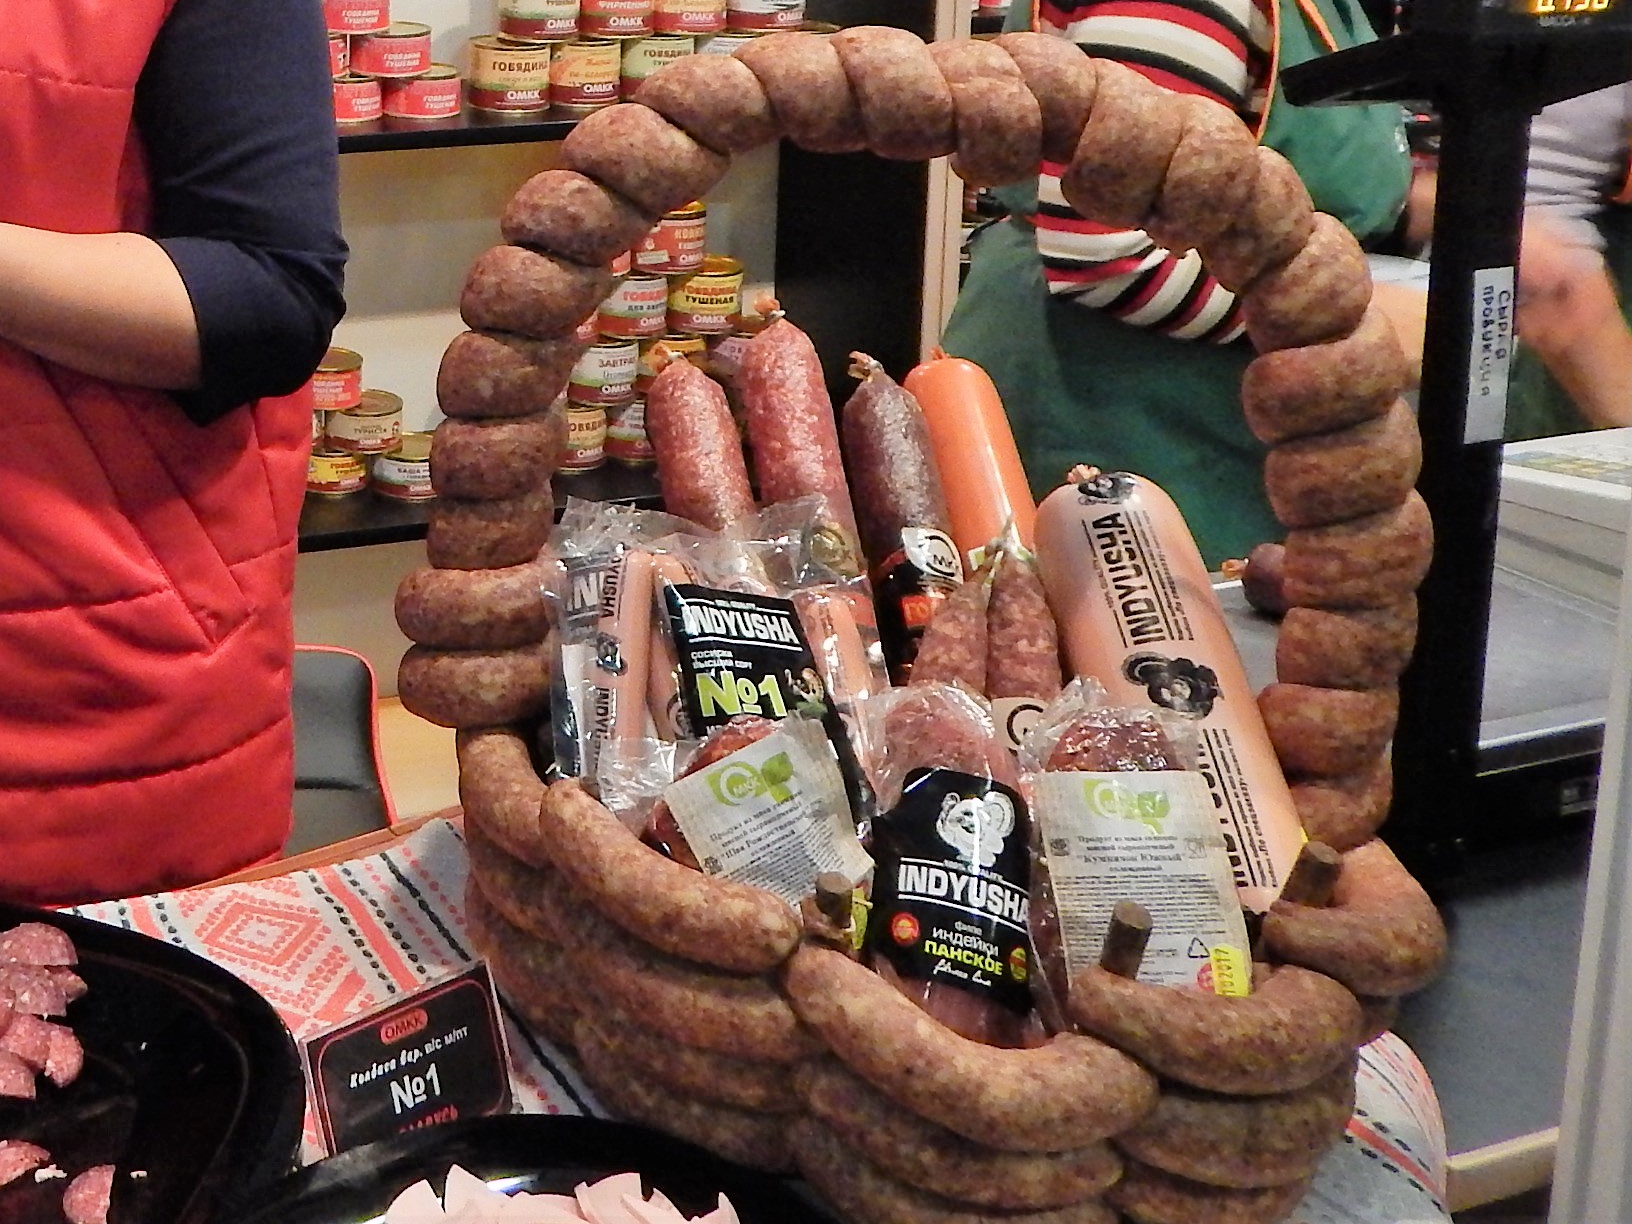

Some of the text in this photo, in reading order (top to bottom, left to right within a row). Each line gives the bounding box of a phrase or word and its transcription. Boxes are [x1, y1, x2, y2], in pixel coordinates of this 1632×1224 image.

[1092, 512, 1166, 645] INDYUSHA
[681, 605, 801, 645] INDYUSHA
[898, 864, 1029, 923] INDYUSHA
[924, 940, 1003, 976] ПАНСКОЕ
